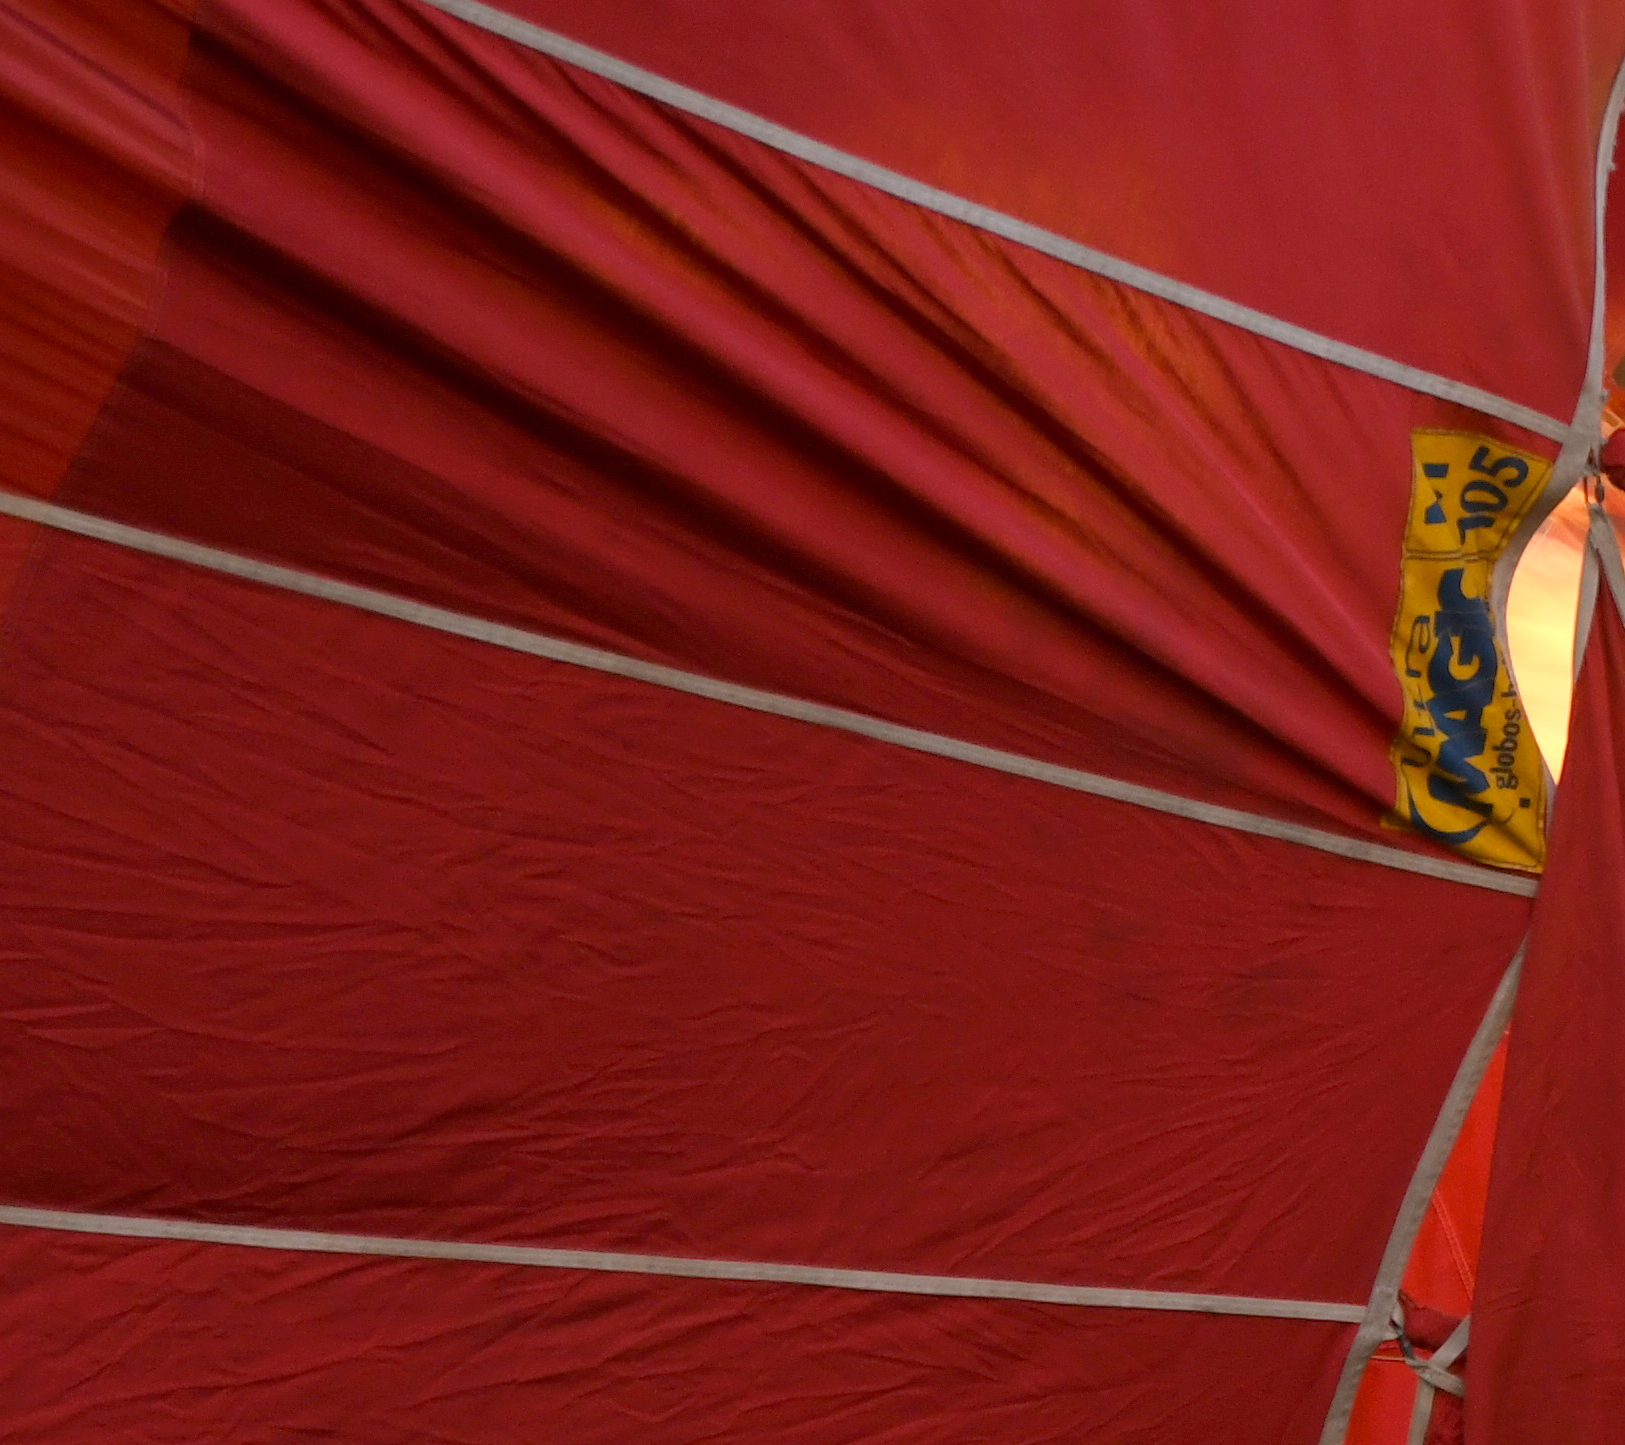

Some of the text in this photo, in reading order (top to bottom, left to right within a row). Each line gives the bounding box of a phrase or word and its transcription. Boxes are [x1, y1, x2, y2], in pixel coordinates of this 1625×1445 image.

[1458, 446, 1530, 544] 105
[1426, 568, 1498, 817] MAGIC
[1490, 673, 1521, 790] globos-b
